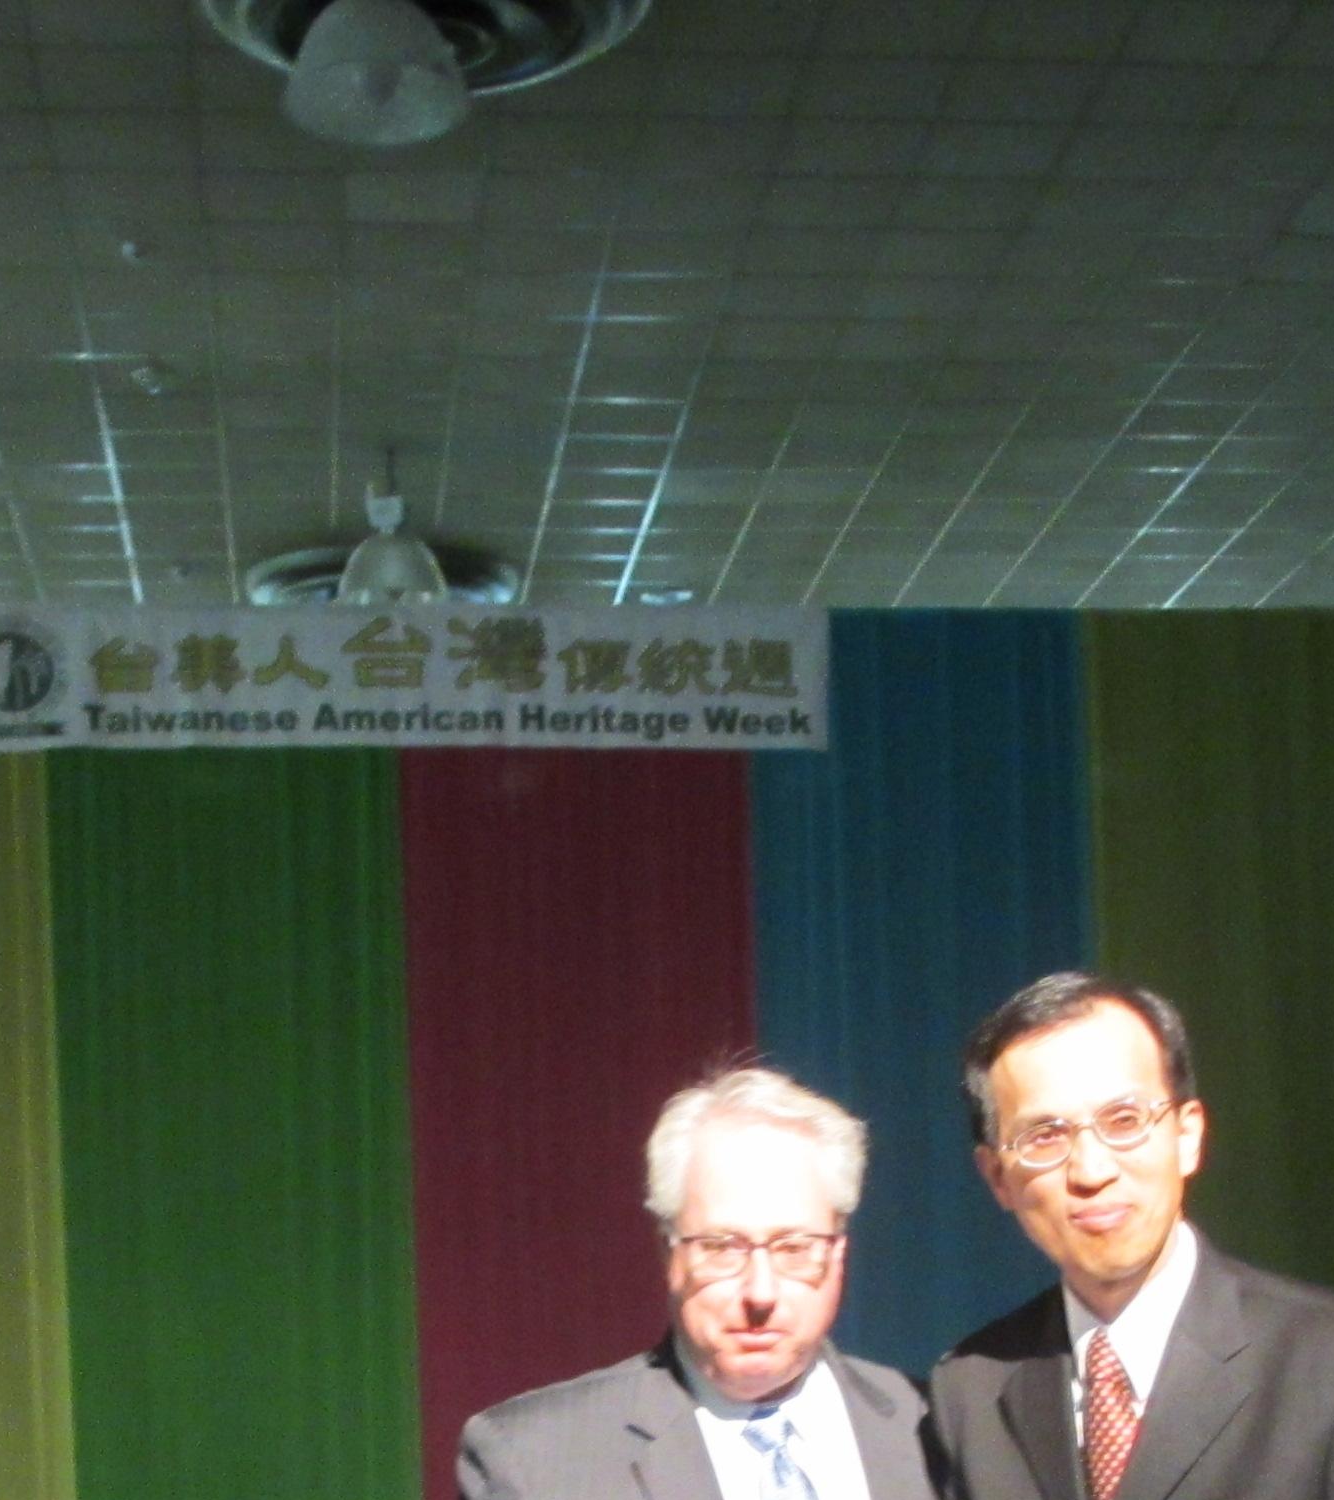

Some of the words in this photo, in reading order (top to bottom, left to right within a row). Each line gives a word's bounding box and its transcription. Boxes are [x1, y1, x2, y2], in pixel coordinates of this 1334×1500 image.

[83, 703, 300, 733] Taiwanese
[314, 702, 505, 733] American
[520, 703, 691, 741] Heritage
[703, 705, 812, 735] Week
